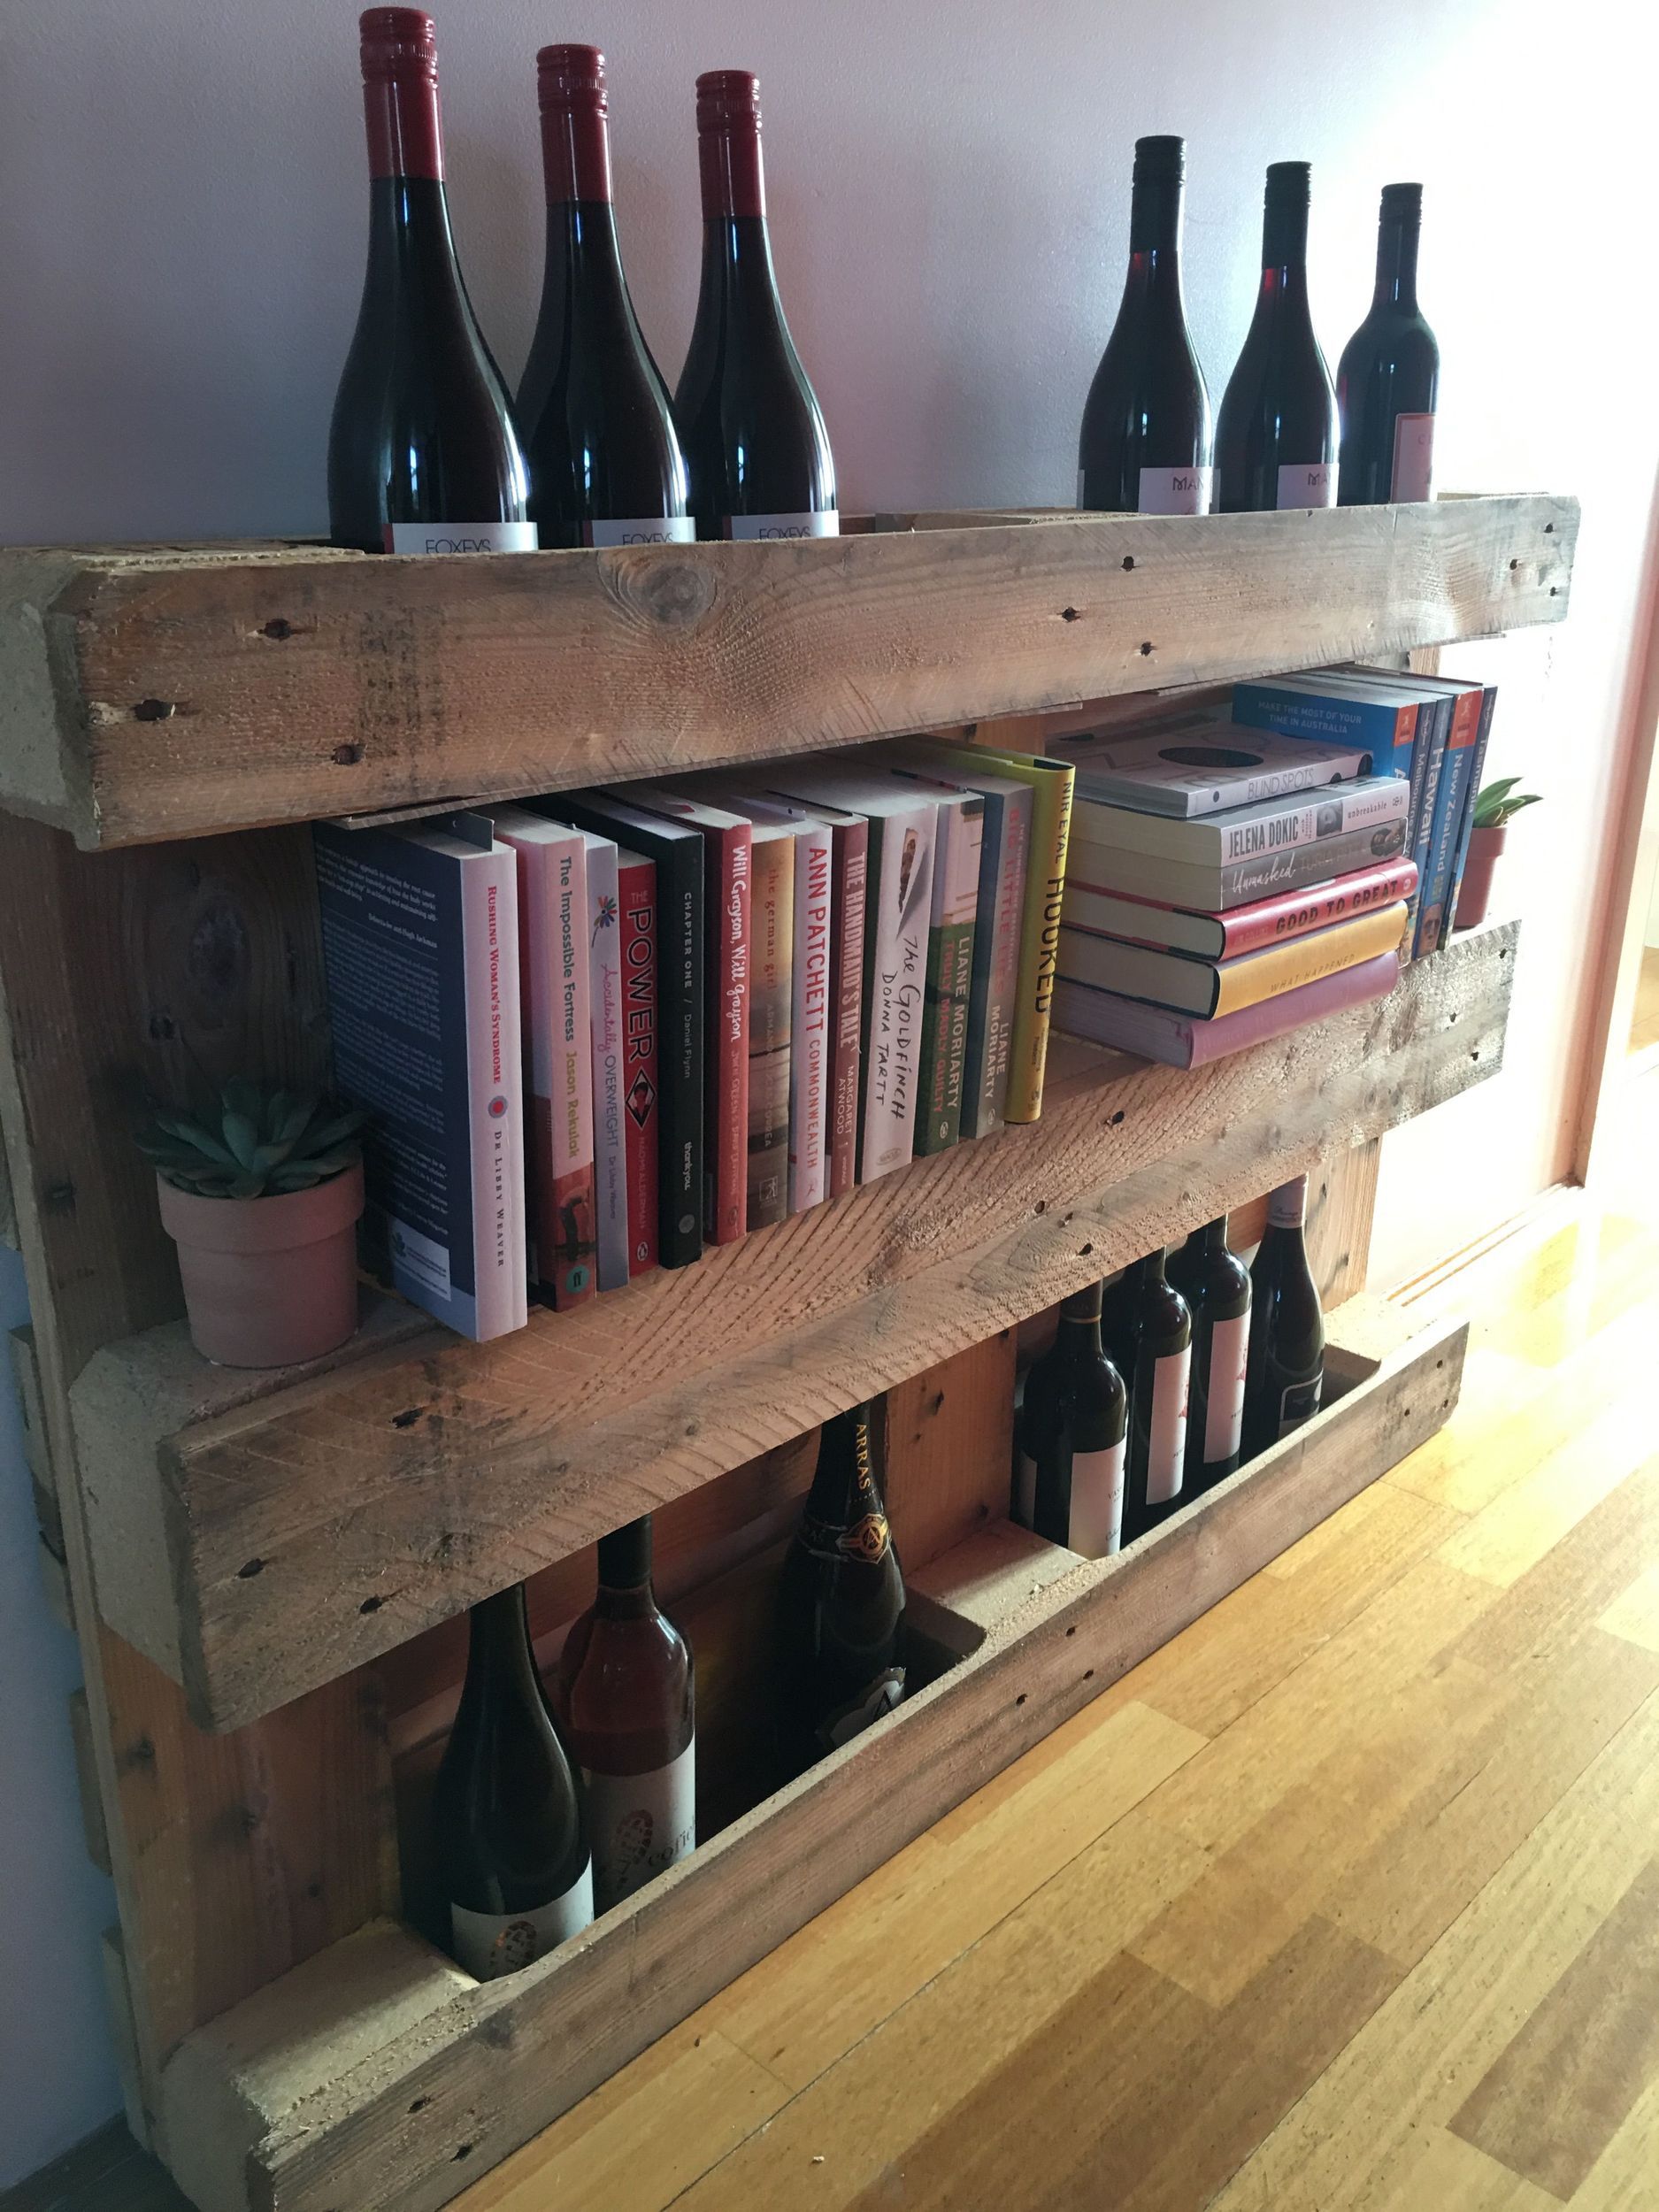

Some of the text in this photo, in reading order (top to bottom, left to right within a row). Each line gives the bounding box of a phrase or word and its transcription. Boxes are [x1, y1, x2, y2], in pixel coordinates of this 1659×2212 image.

[1258, 701, 1363, 725] MAKE THE MOST OF YOUR
[1269, 714, 1348, 733] TIME IN AUSTRALIA
[1248, 768, 1314, 800] BLIND SPOTS
[1408, 753, 1426, 827] Melbourne
[1419, 748, 1444, 845] Hawaii
[1450, 754, 1463, 795] New
[1469, 740, 1486, 814] Tasmania
[1055, 782, 1072, 864] NIR EYAL
[1229, 824, 1265, 858] JELENA
[1269, 816, 1299, 848] DOKIC
[1348, 801, 1388, 818] unbreakable
[1437, 799, 1456, 872] Zealand
[733, 845, 748, 879] Will
[631, 891, 648, 904] THE
[684, 892, 693, 956] CHAPTER
[764, 901, 775, 956] german
[994, 809, 1021, 997] BIG LITTLE LIES
[1276, 880, 1398, 935] GOOD TO GREAT
[684, 960, 693, 988] ONE
[840, 851, 866, 1052] THE HANDMAID'S TALE
[903, 935, 918, 973] The
[1035, 876, 1065, 1014] HOOKED
[1271, 954, 1356, 993] WHAT HAPPENED
[488, 886, 502, 1084] RUSHING WOMAN'S SYNDROME
[559, 856, 579, 1158] The Impossible Fortress Jason Rekulak
[598, 964, 618, 1053] Accidentally
[626, 905, 653, 1064] POWER
[806, 848, 828, 1169] ANN PATCHETT COMMONWEALTH
[684, 1014, 693, 1049] Daniel
[876, 970, 898, 1106] DONNA TARTT
[933, 941, 955, 1112] TRULY MADLY GUILTY
[948, 936, 971, 1108] LIANE MORIARTY
[985, 1005, 1001, 1099] MORIARTY
[996, 1022, 1010, 1075] LIANE
[683, 1050, 693, 1079] Flynn
[605, 1056, 618, 1147] OVERWEIGHT
[836, 1079, 846, 1135] ATWOOD
[845, 1065, 856, 1133] MARGARET
[494, 1131, 505, 1267] DR LIBBY WEAVER
[855, 1423, 872, 1491] ARRAS
